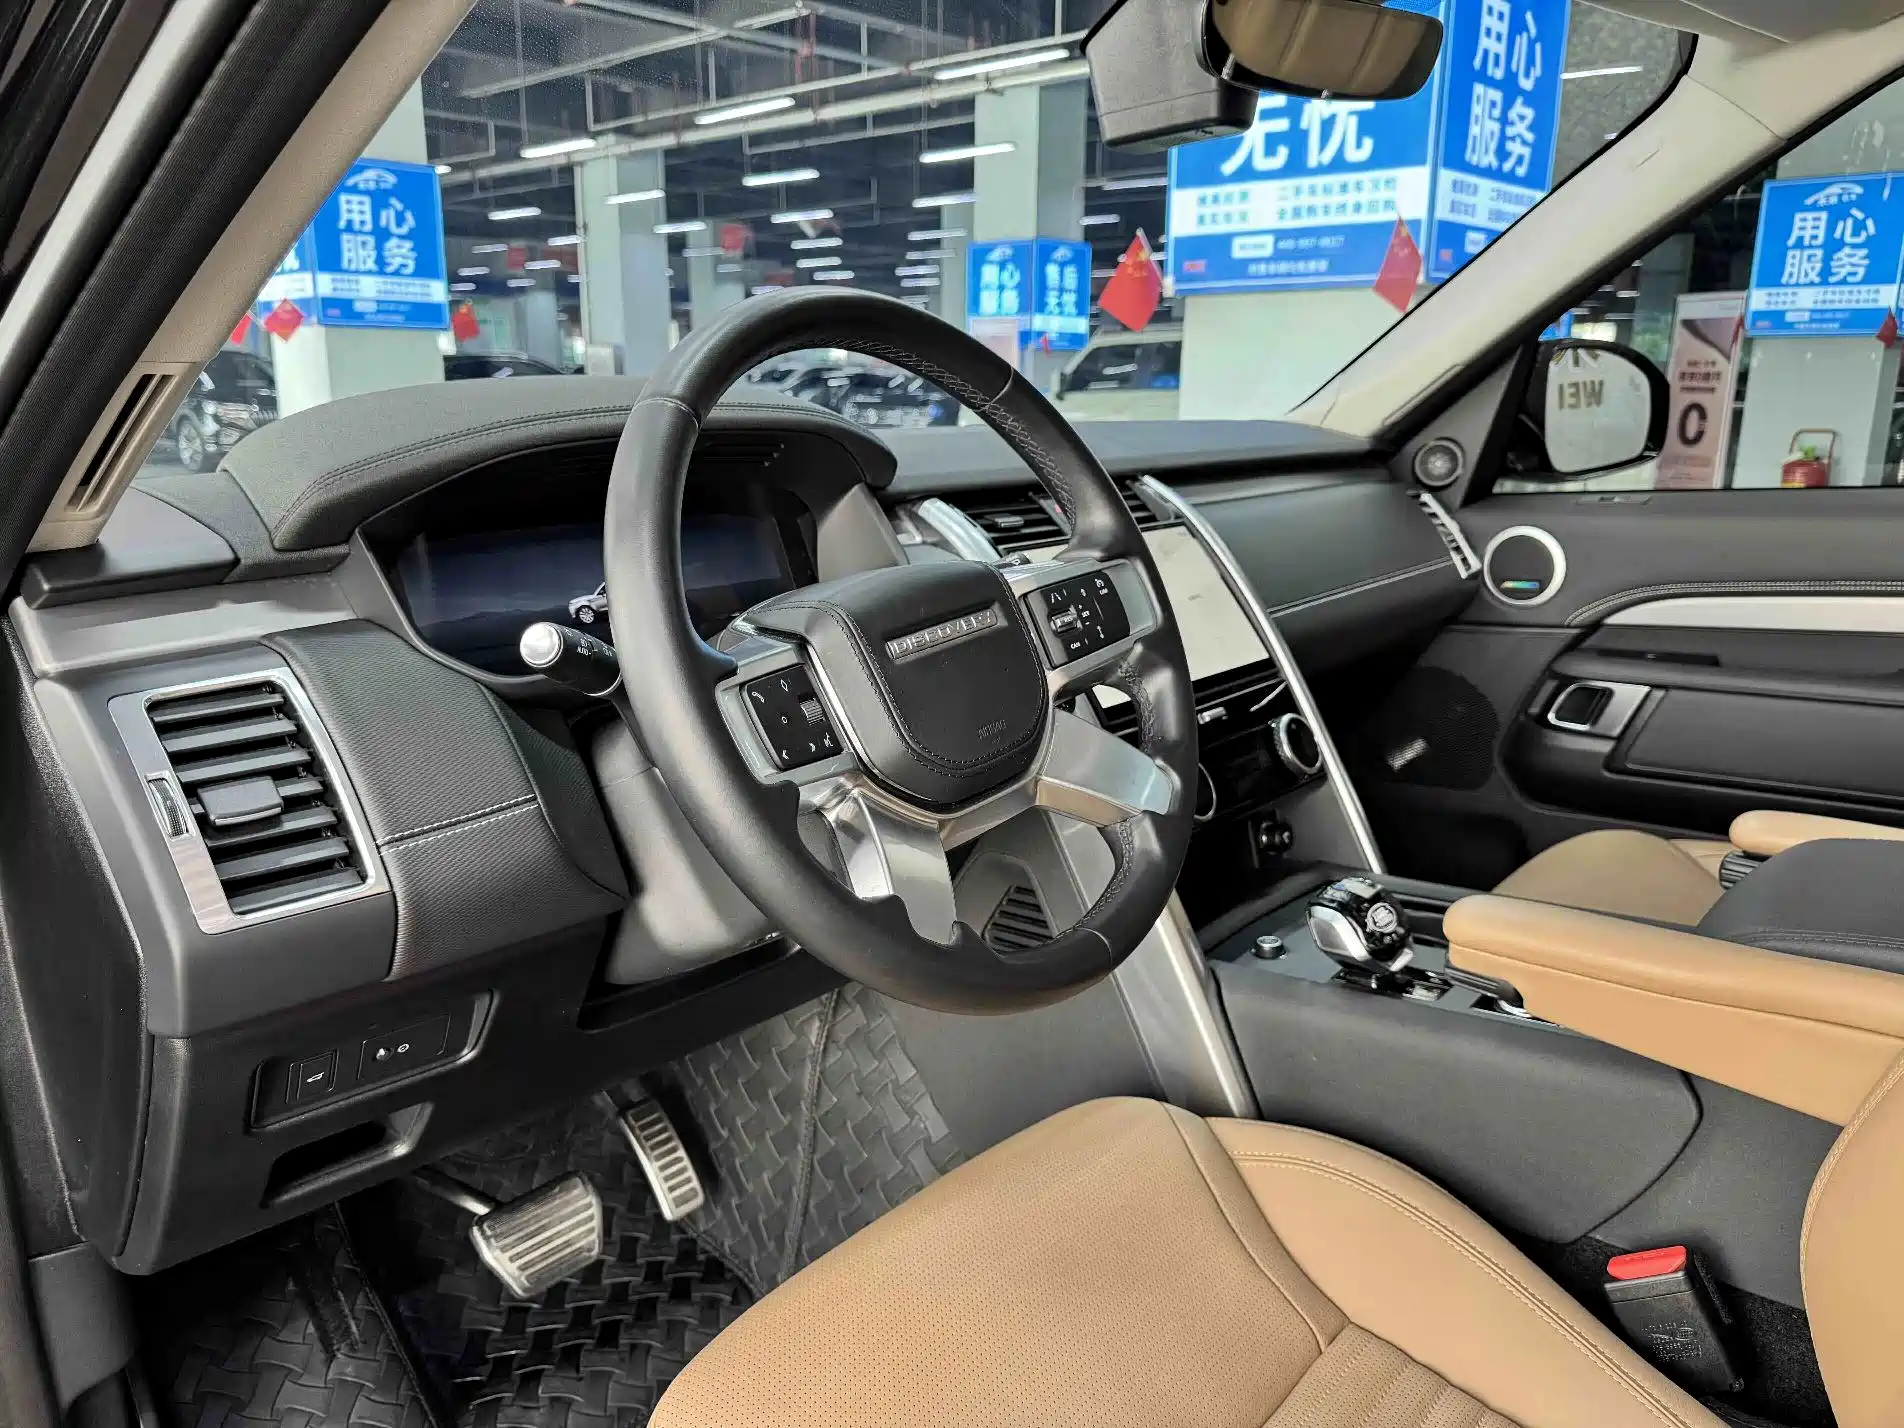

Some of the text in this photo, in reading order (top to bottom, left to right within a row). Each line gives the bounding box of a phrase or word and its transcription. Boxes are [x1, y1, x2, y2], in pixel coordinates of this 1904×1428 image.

[1473, 0, 1542, 91] 用心
[1220, 94, 1376, 176] 无忧
[1464, 82, 1536, 178] 服务
[337, 192, 416, 235] 用心
[1786, 207, 1876, 247] 用心
[341, 233, 417, 275] 服务
[1781, 245, 1870, 285] 服务
